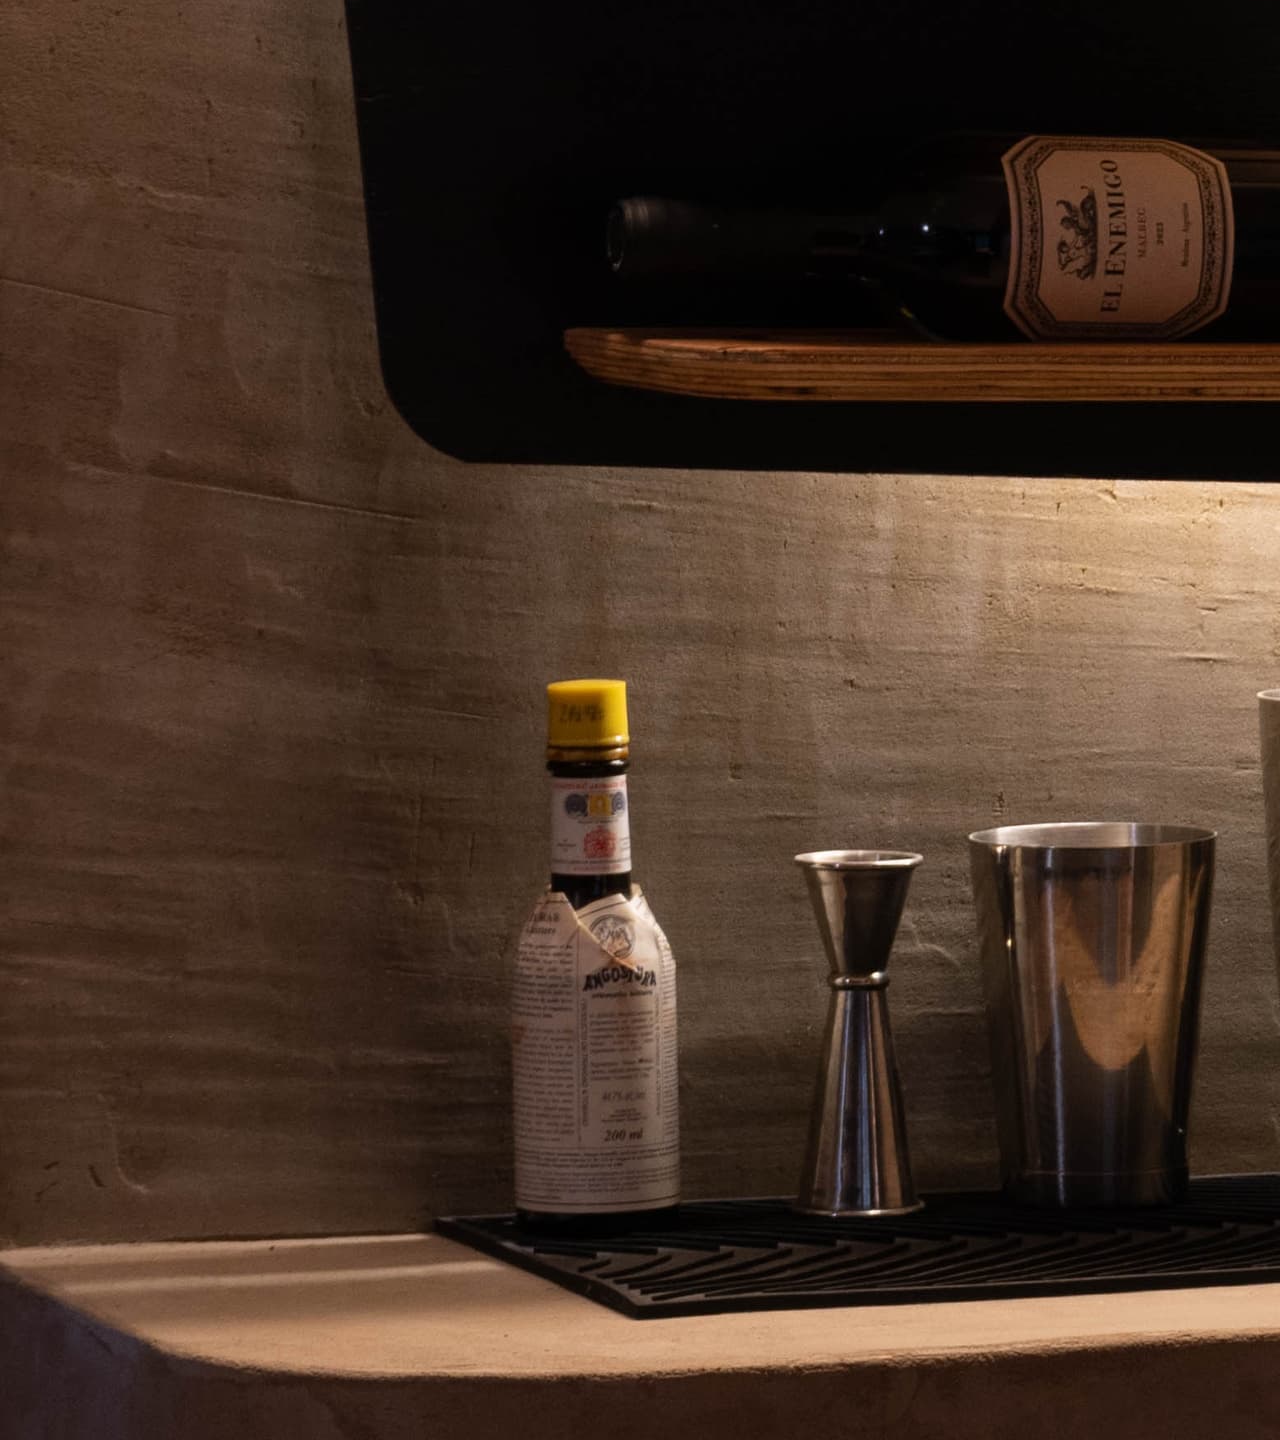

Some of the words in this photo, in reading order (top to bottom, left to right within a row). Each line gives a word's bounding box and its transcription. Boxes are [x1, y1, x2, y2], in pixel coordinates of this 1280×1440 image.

[1099, 159, 1127, 276] ENEMIGO
[1100, 284, 1123, 313] EL
[603, 1128, 627, 1142] 200
[629, 1127, 643, 1140] ml
